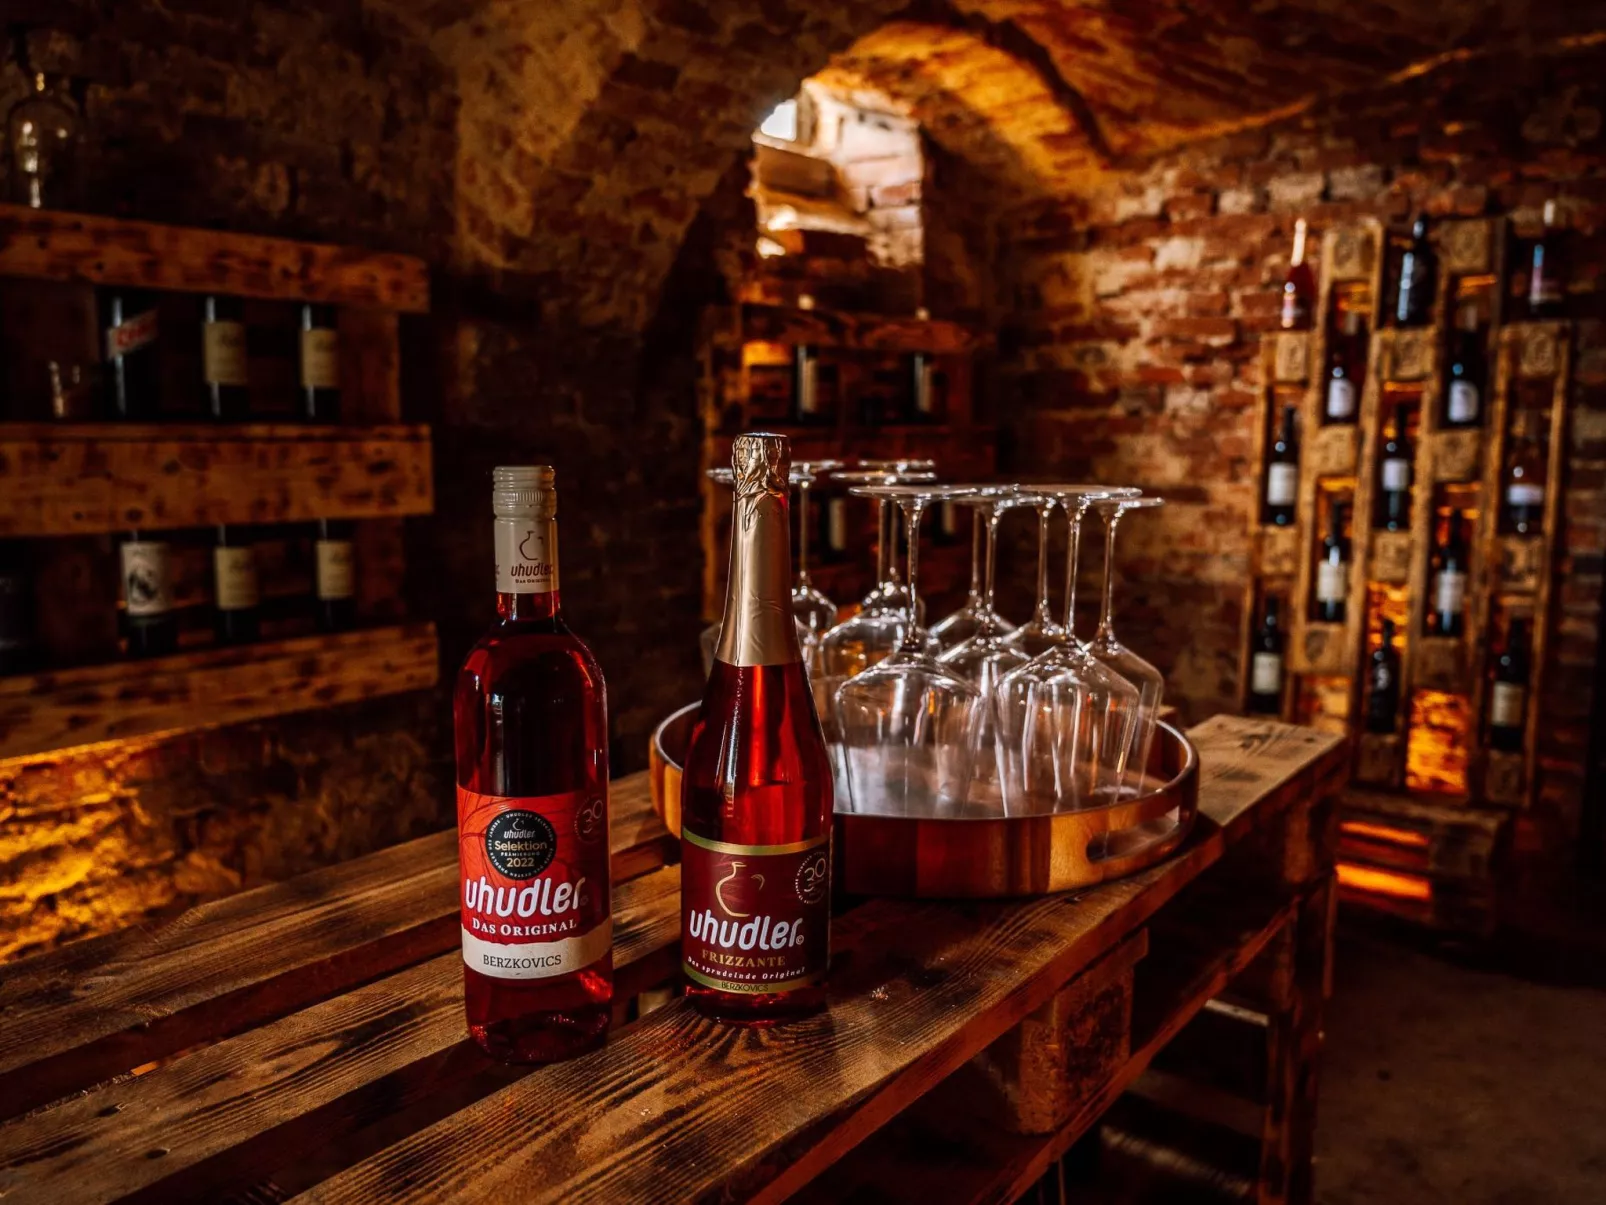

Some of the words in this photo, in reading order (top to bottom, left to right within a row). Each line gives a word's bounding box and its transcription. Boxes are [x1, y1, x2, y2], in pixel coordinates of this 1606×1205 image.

[503, 829, 536, 839] uhudler
[494, 840, 548, 851] Selektion
[506, 857, 535, 868] 2022
[465, 875, 586, 918] uhudler
[472, 917, 496, 934] DAS
[500, 918, 577, 936] ORIGINAL
[483, 954, 562, 969] BERZKOVICS
[701, 949, 786, 968] FRIZZANTE
[687, 955, 699, 968] Das
[701, 965, 757, 980] sprudelnde
[762, 966, 806, 980] Original
[721, 982, 769, 992] BERZKOVICS
